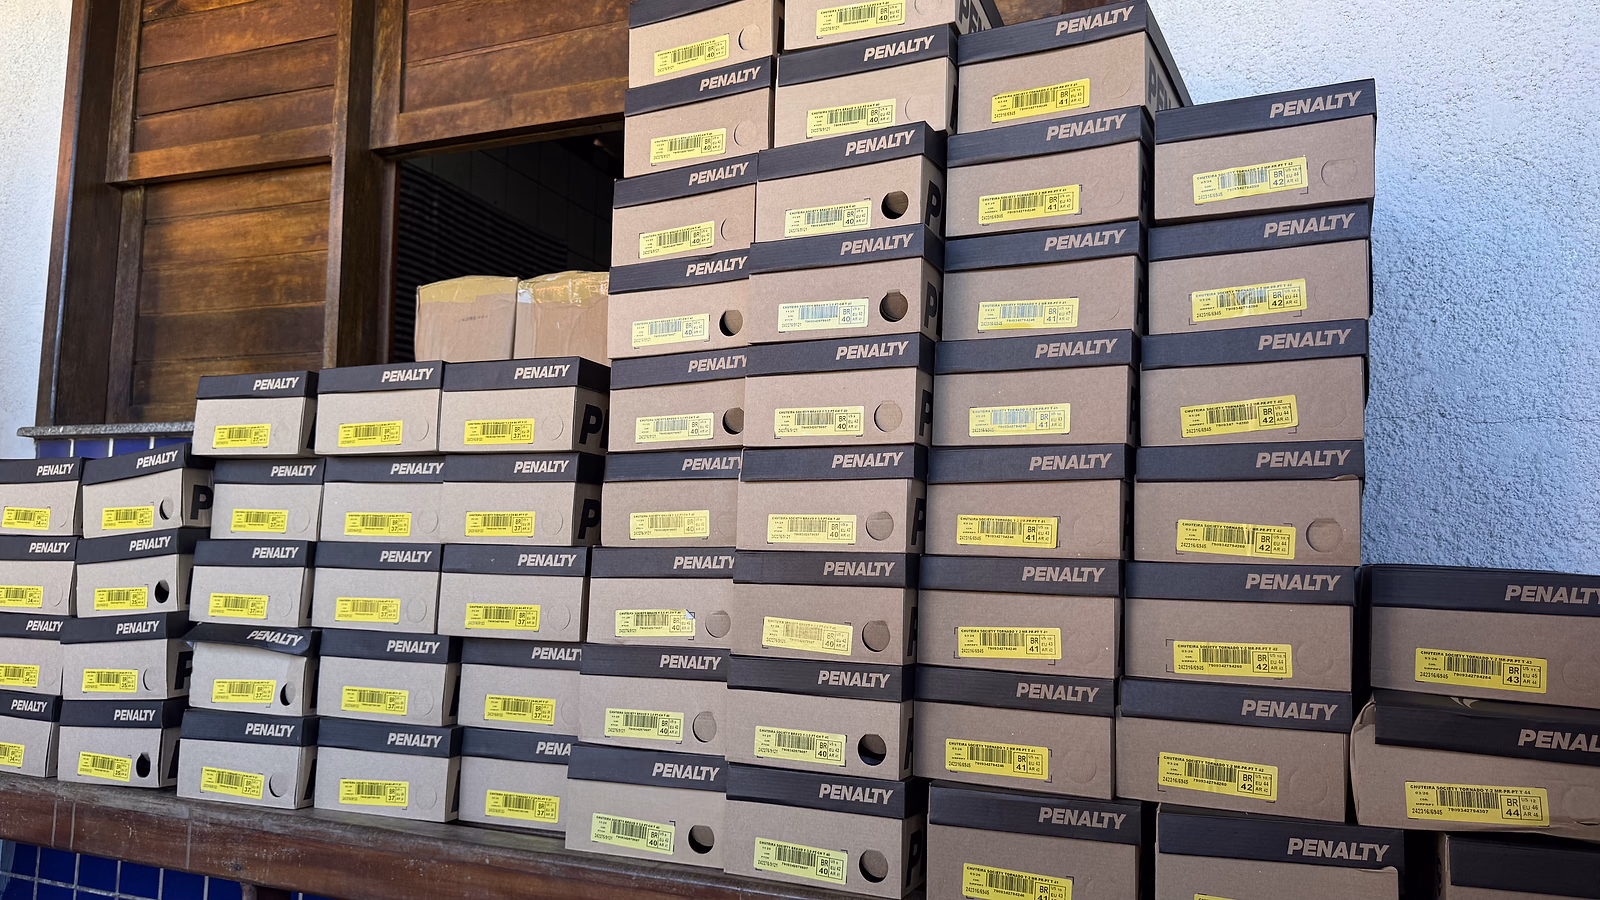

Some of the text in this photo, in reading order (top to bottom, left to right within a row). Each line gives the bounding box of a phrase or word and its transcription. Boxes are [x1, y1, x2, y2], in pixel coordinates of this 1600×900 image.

[1055, 5, 1134, 36] PENALTY
[864, 35, 935, 61] PENALTY
[700, 66, 761, 92] PENALTY
[1270, 90, 1361, 118] PENALTY
[1046, 113, 1127, 141] PENALTY
[845, 131, 916, 156] PENALTY
[689, 162, 749, 186] PENALTY
[1264, 213, 1355, 238] PENALTY
[840, 233, 914, 255] PENALTY
[1044, 229, 1126, 251] PENALTY
[686, 261, 748, 277] PENALTY
[1258, 329, 1351, 350] PENALTY
[836, 341, 909, 361] PENALTY
[1035, 338, 1118, 358] PENALTY
[688, 355, 747, 373] PENALTY
[381, 368, 434, 383] PENALTY
[514, 365, 571, 380] PENALTY
[253, 377, 300, 390] PENALTY
[136, 451, 178, 469] PENALTY
[514, 460, 569, 473] PENALTY
[832, 452, 904, 470] PENALTY
[1029, 453, 1112, 471] PENALTY
[1256, 450, 1351, 467] PENALTY
[36, 463, 75, 476] PENALTY
[271, 465, 317, 477] PENALTY
[390, 463, 445, 474] PENALTY
[29, 542, 71, 553] PENALTY
[129, 536, 171, 551] PENALTY
[252, 547, 299, 558] PENALTY
[380, 551, 432, 563] PENALTY
[517, 554, 577, 567] PENALTY
[674, 556, 735, 569] PENALTY
[823, 562, 895, 576] PENALTY
[1022, 567, 1105, 582] PENALTY
[1246, 574, 1341, 591] PENALTY
[25, 620, 64, 632] PENALTY
[116, 620, 160, 634] PENALTY
[247, 631, 303, 646] PENALTY
[386, 640, 440, 654] PENALTY
[531, 647, 581, 661] PENALT
[660, 655, 722, 670] PENALTY
[818, 670, 890, 688] PENALTY
[1016, 683, 1099, 702] PENALTY
[11, 699, 47, 713] PENALTY
[1242, 700, 1338, 720] PENALTY
[114, 709, 156, 721] PENALTY
[245, 723, 295, 737] PENALTY
[387, 733, 443, 748] PENALTY
[536, 741, 572, 756] PENA
[1518, 729, 1600, 752] PENAL
[652, 763, 720, 781] PENALTY
[819, 784, 893, 804] PENALTY
[1039, 807, 1126, 829] PENALTY
[1288, 838, 1389, 861] PENALTY
